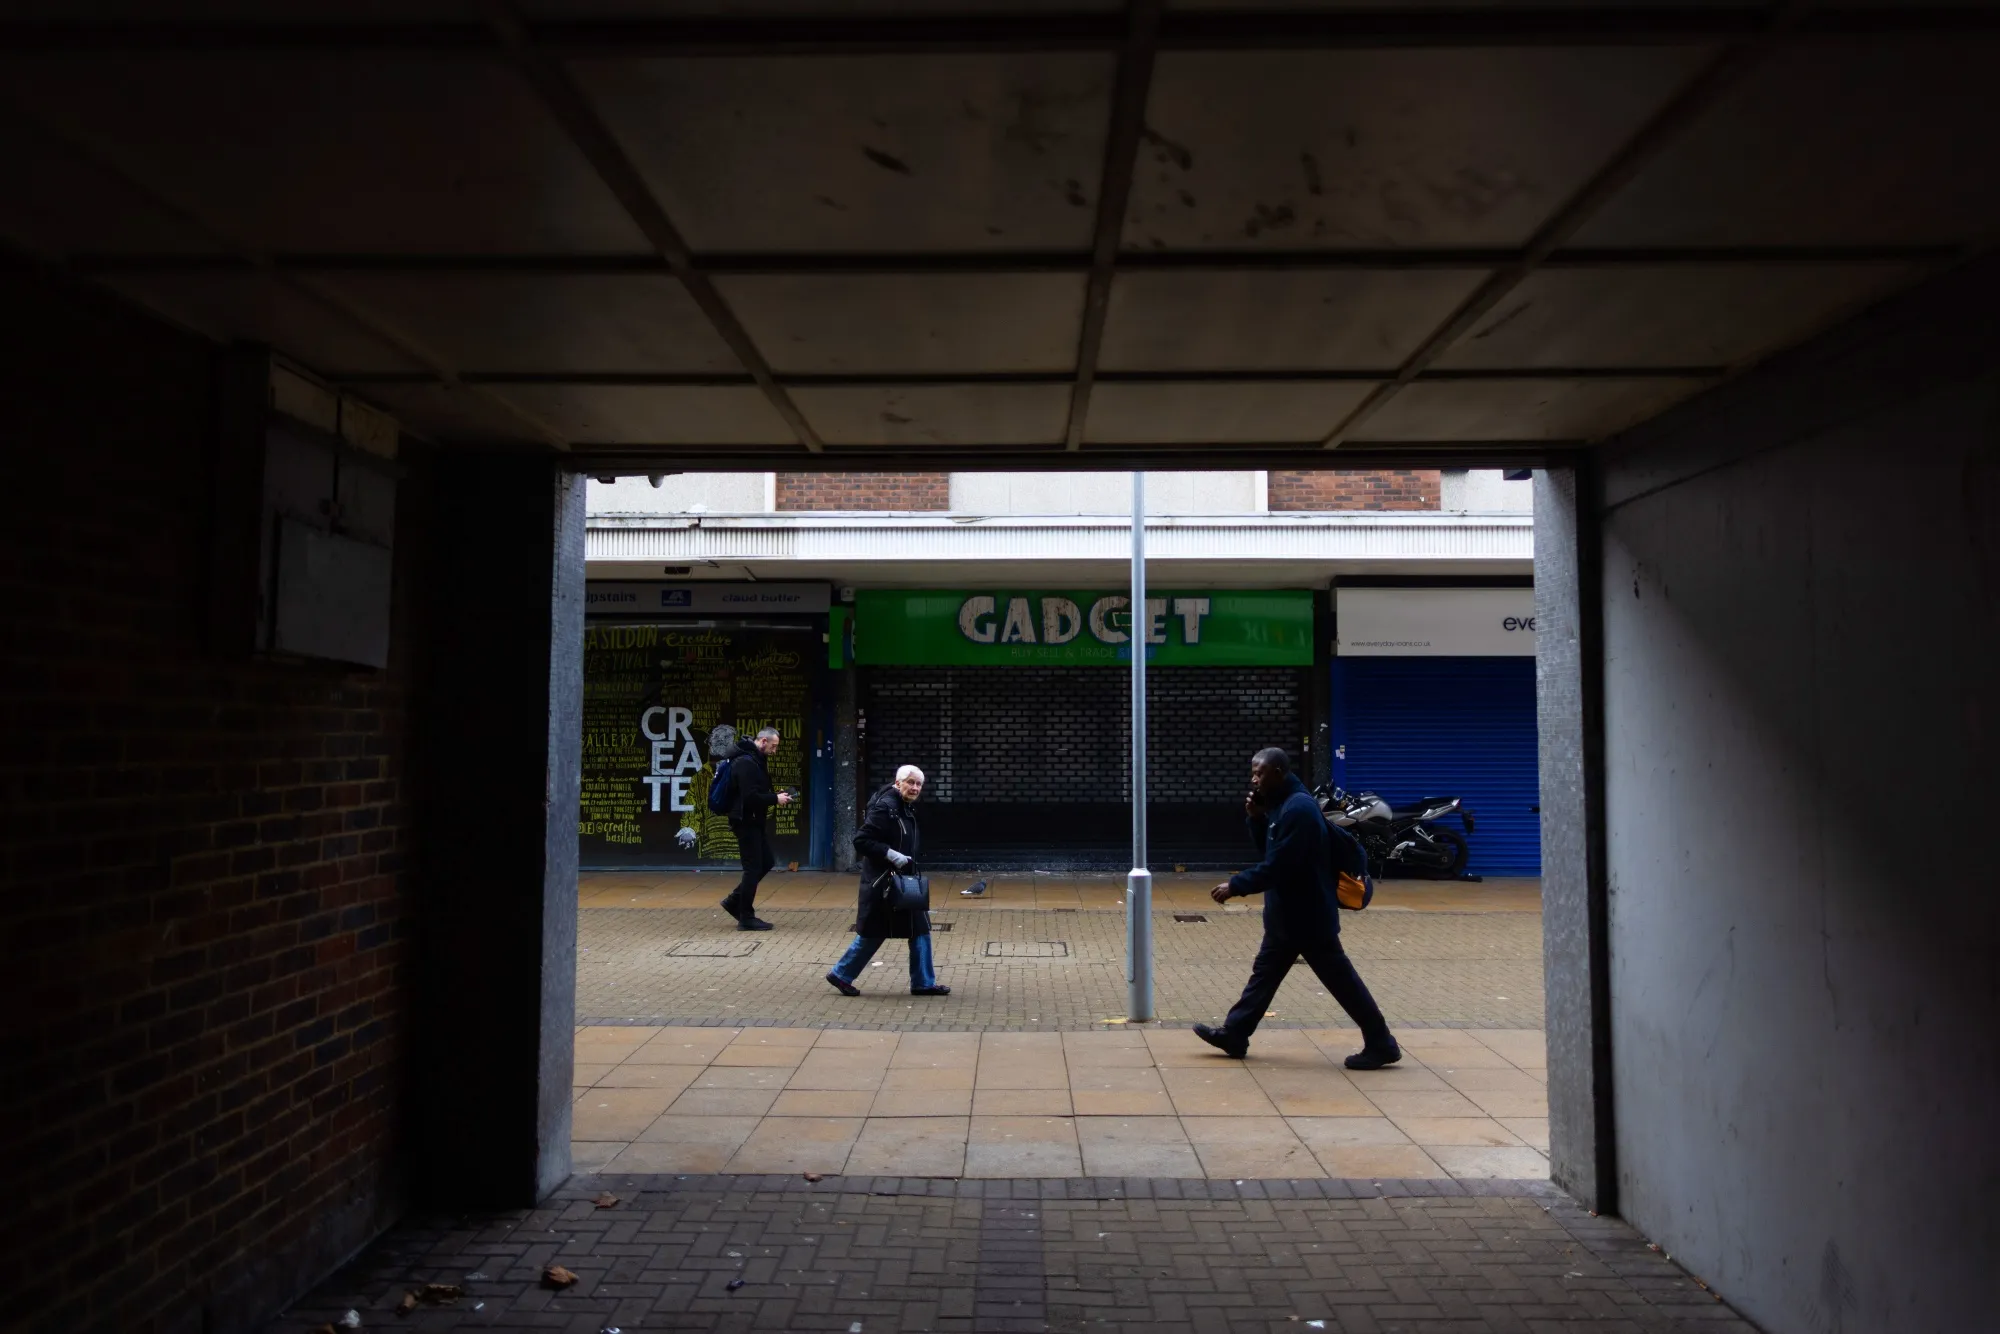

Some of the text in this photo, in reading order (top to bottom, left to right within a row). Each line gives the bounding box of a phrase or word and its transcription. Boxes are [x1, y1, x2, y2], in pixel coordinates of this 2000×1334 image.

[722, 593, 800, 603] claud butler
[958, 596, 1210, 644] GADGET
[585, 625, 659, 650] ASILDON
[585, 652, 653, 674] ESTIVAL
[1011, 648, 1032, 658] BUY
[1037, 648, 1061, 658] SELL
[1066, 648, 1074, 658] &
[1080, 648, 1114, 658] TRADE
[640, 705, 695, 741] CR
[651, 740, 704, 776] EA
[642, 776, 695, 812] TE
[605, 831, 642, 844] basildon
